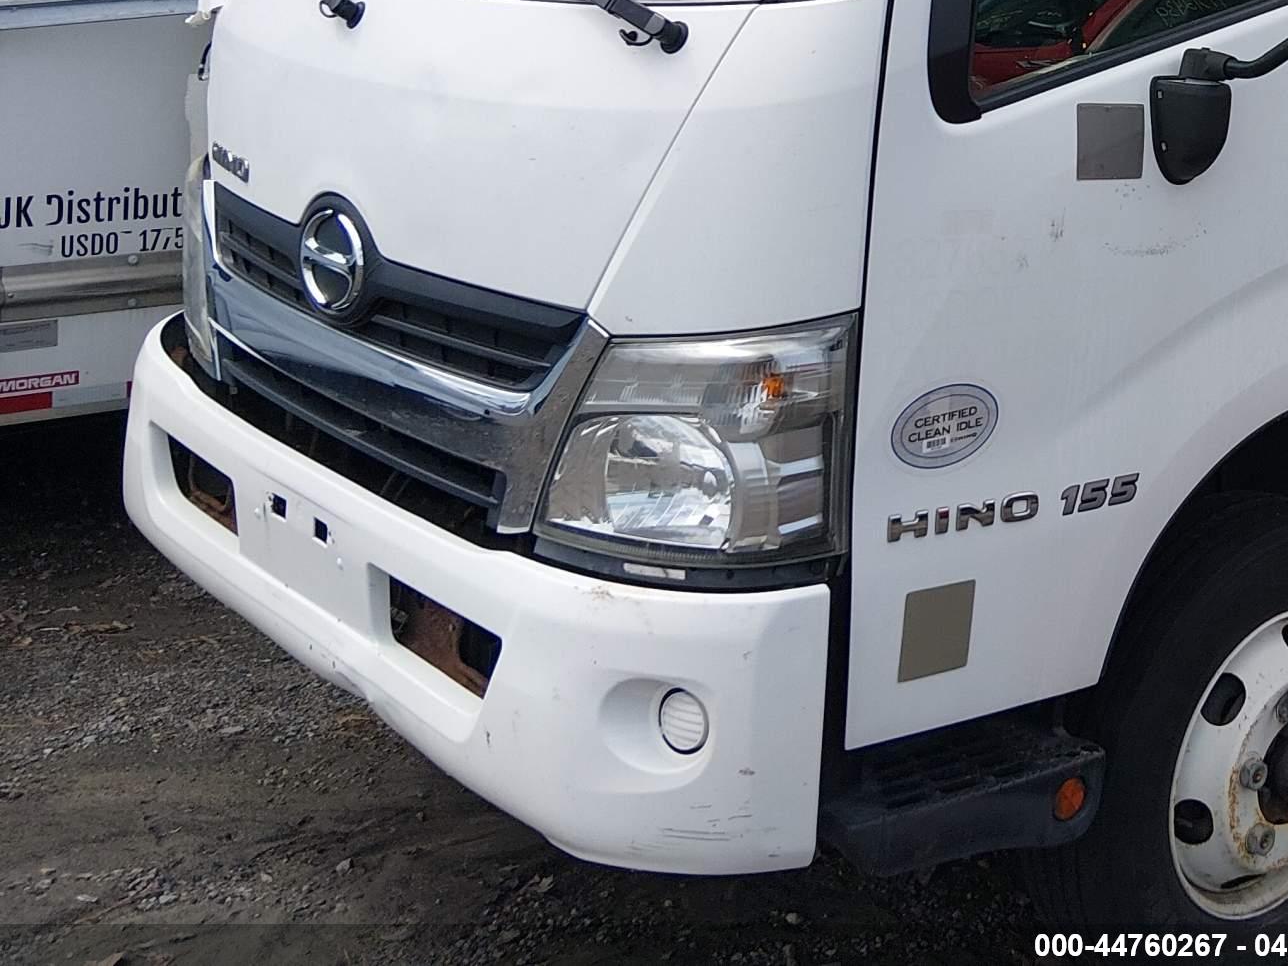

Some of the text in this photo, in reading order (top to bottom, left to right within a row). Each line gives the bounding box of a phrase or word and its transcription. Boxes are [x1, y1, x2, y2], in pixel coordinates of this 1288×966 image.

[61, 230, 132, 258] USDO
[0, 374, 76, 391] MORGAN
[908, 425, 951, 443] CLEAN
[956, 416, 983, 432] IDLE
[914, 405, 978, 429] CERTIFIED
[887, 472, 1140, 543] HINO 155
